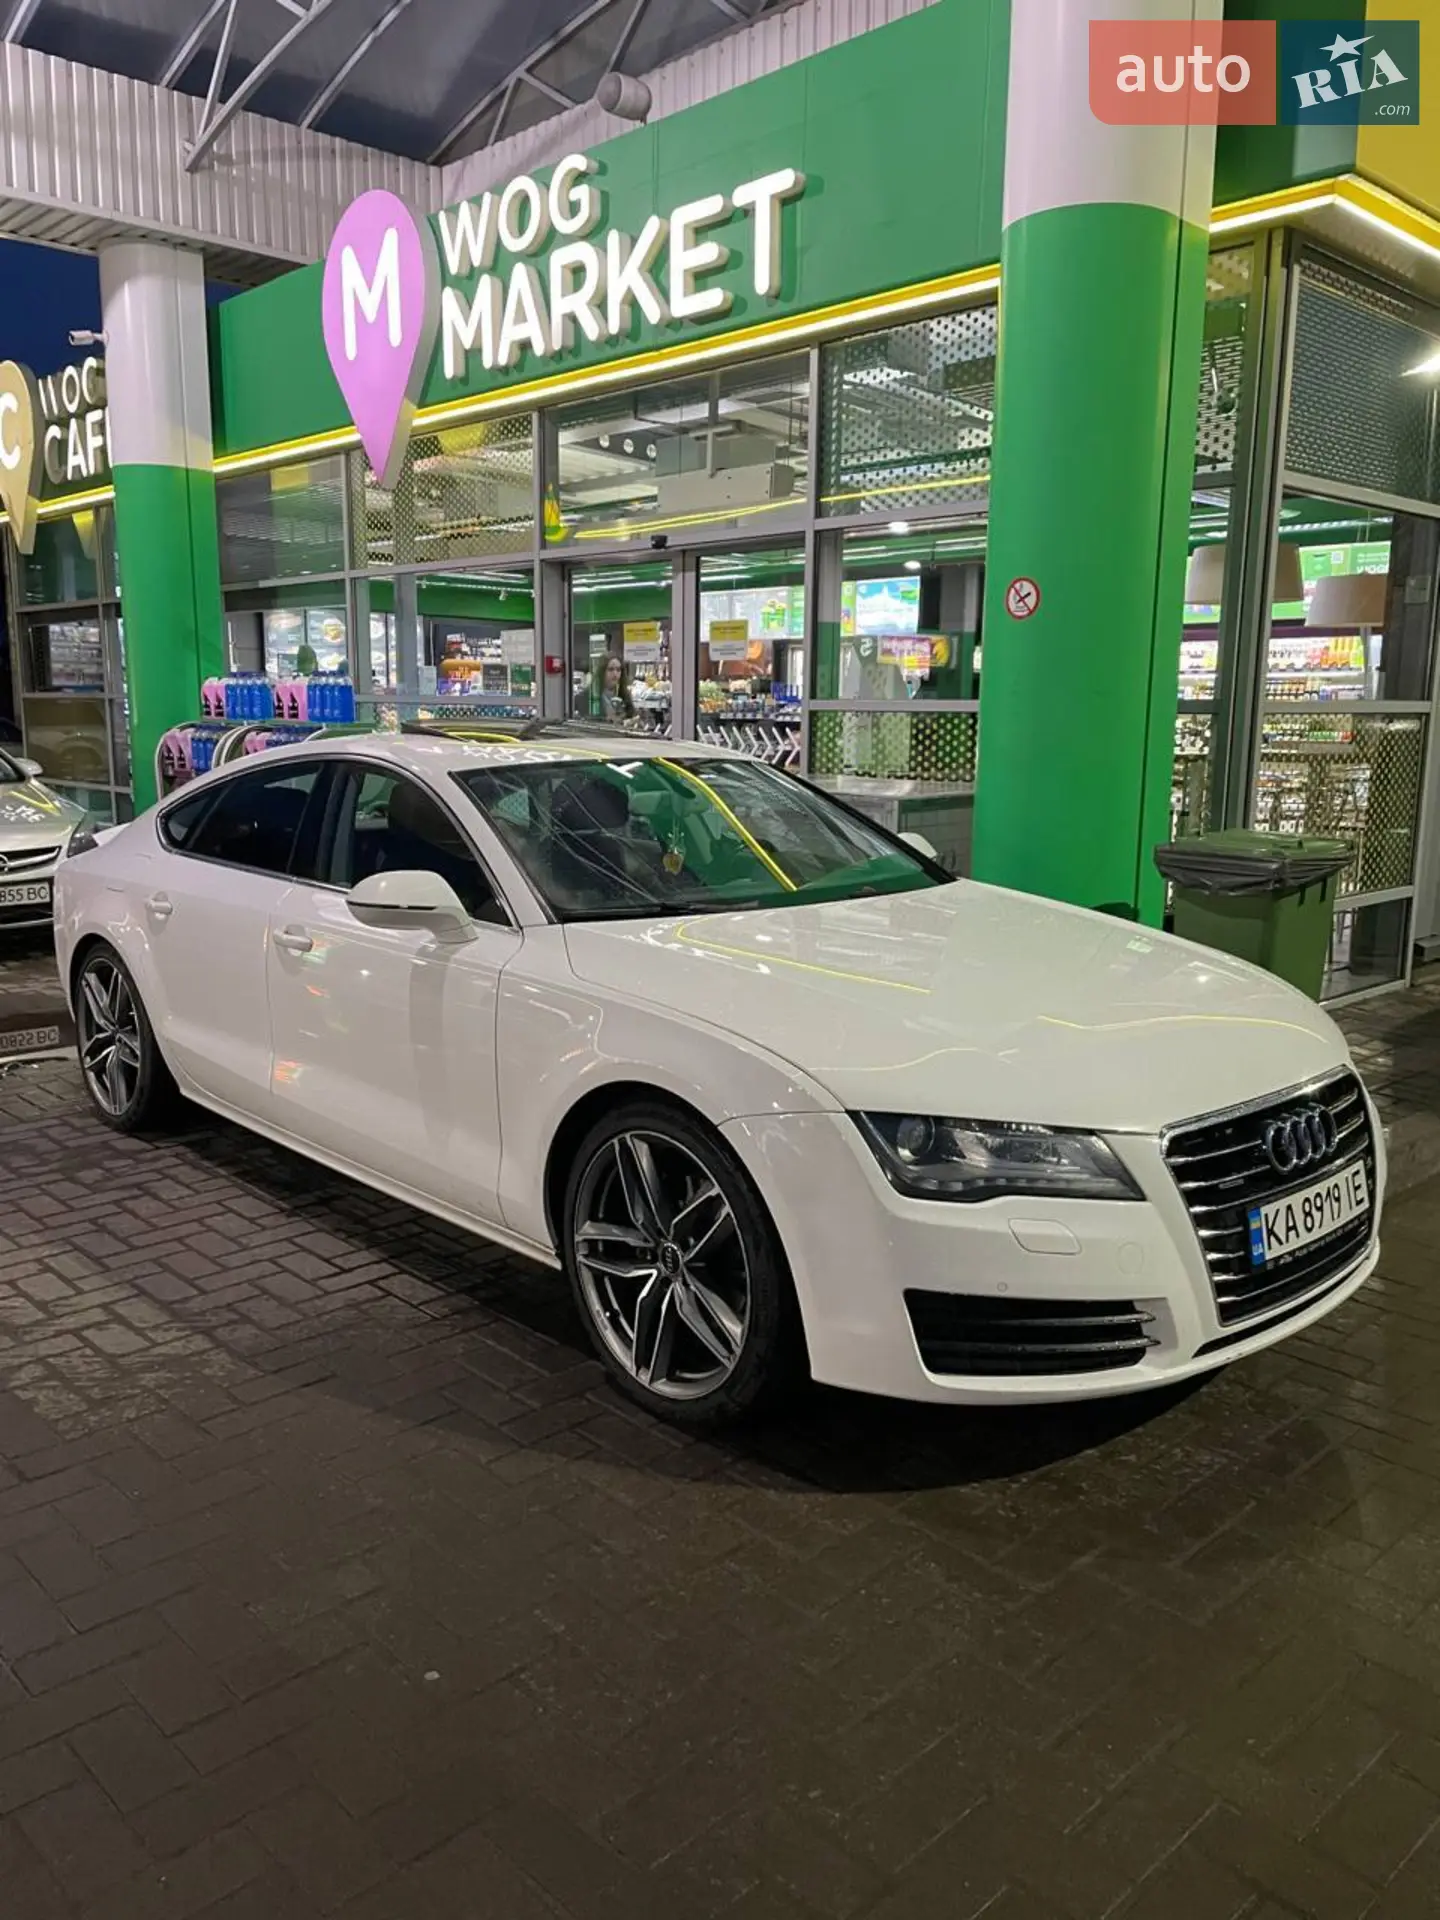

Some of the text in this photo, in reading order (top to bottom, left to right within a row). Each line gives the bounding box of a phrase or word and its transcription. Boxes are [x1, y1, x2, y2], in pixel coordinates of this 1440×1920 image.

[438, 153, 592, 276] WOG
[341, 228, 402, 360] M
[441, 168, 797, 380] MARKET
[0, 392, 20, 470] C
[27, 886, 48, 900] BC
[1264, 1204, 1299, 1251] KA
[1302, 1183, 1341, 1233] 8919
[1345, 1169, 1365, 1211] IE
